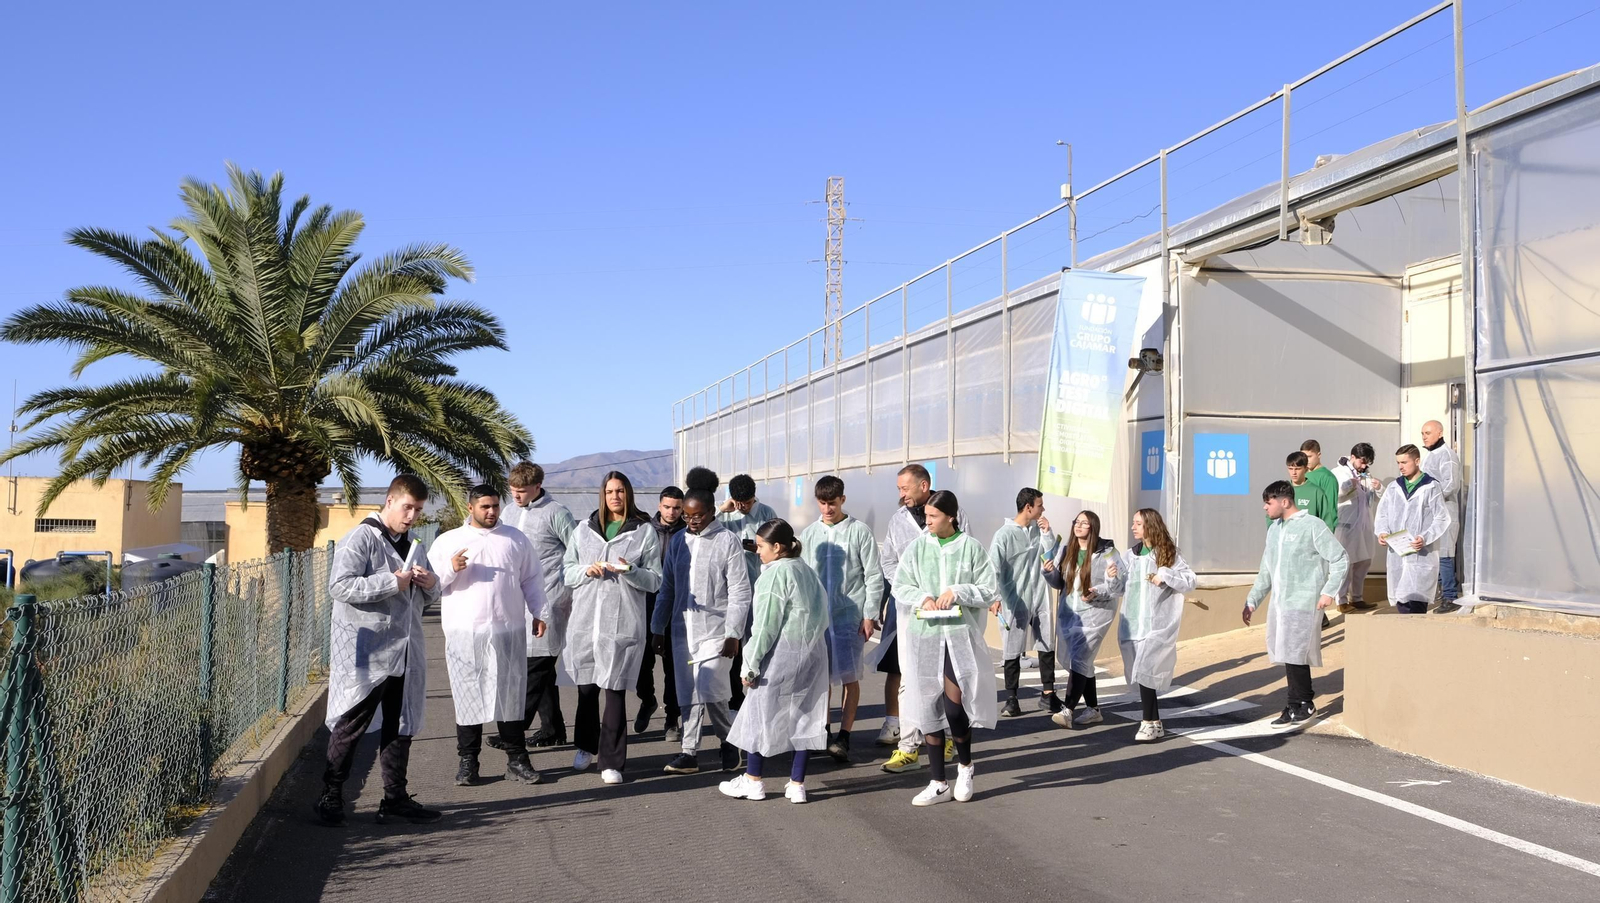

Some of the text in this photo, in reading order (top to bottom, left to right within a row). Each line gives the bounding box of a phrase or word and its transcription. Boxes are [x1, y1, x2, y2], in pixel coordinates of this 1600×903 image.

[1076, 332, 1111, 344] GRUPO
[1069, 339, 1117, 354] CAJAMAR
[1059, 385, 1091, 402] TEST
[1056, 399, 1111, 421] DIGITAL
